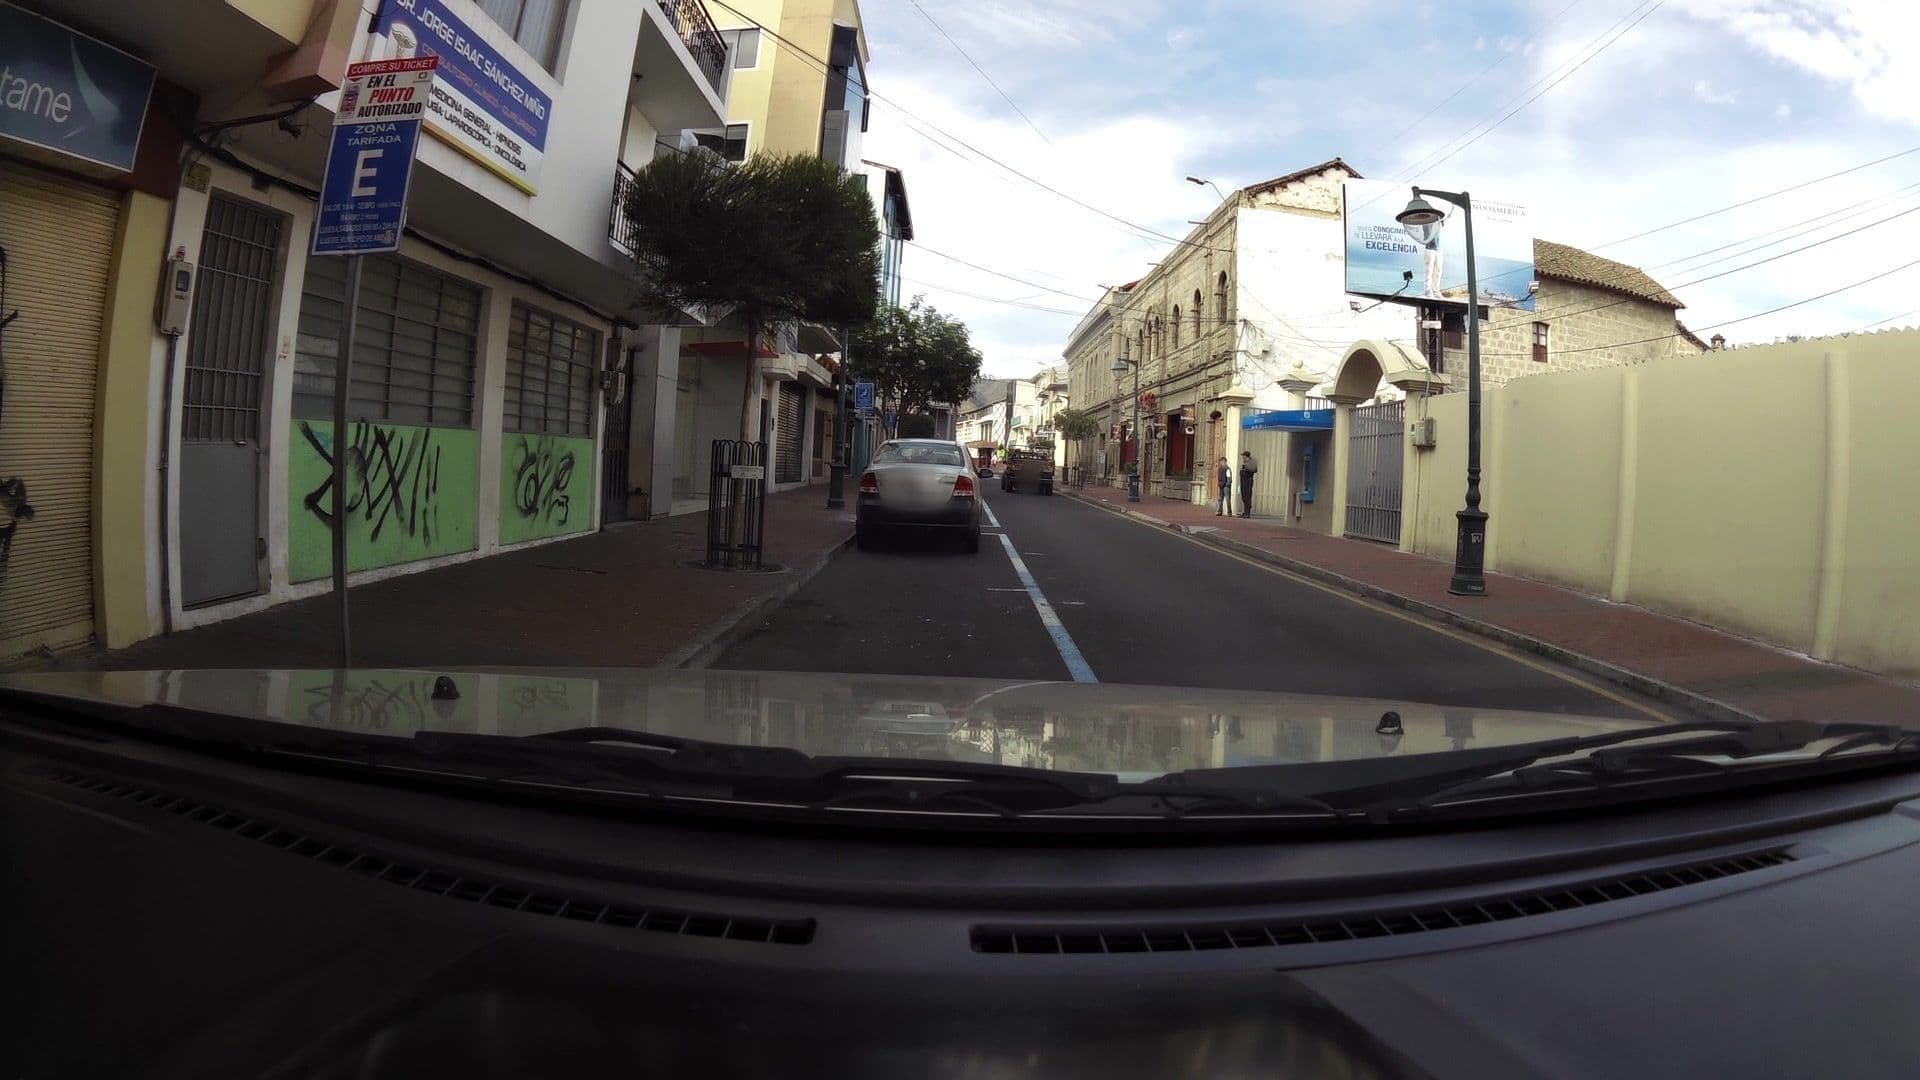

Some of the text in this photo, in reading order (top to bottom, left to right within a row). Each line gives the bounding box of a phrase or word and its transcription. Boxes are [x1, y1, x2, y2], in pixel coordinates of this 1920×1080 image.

[351, 59, 435, 74] COMPRE SU TICKET
[417, 7, 455, 46] JORGE
[454, 34, 484, 70] ISAAC
[483, 60, 525, 104] SÁNCHEZ
[524, 93, 545, 120] MIÑO
[367, 74, 397, 89] EN EL
[0, 65, 72, 123] tame
[368, 87, 415, 104] PUNTO
[357, 102, 422, 118] AUTORIZADO
[429, 83, 463, 114] MEDICINA
[463, 106, 492, 135] GENERAL
[496, 130, 522, 156] HIPNOSIS
[354, 123, 396, 135] ZONA
[347, 135, 401, 146] TARIFADA
[351, 149, 384, 197] E
[1365, 240, 1418, 254] EXCELENCIA
